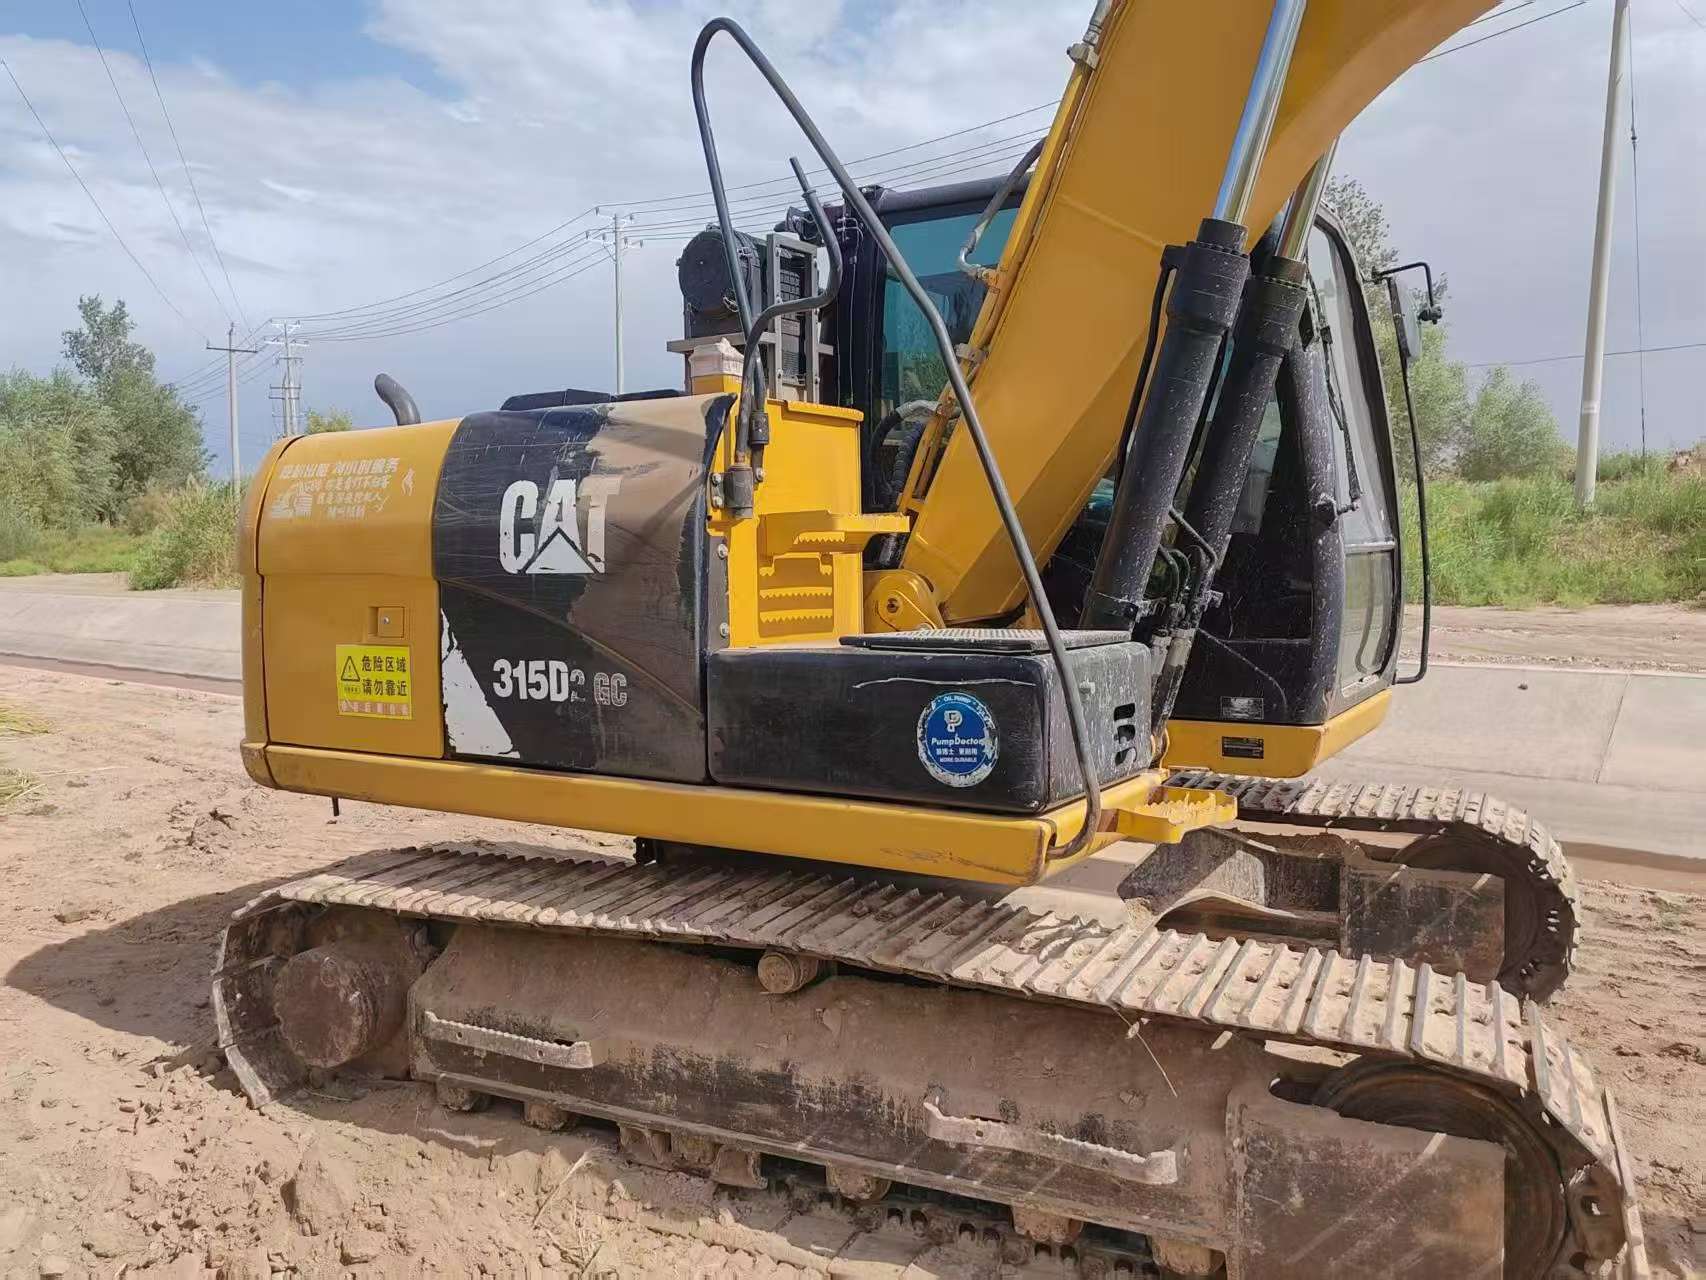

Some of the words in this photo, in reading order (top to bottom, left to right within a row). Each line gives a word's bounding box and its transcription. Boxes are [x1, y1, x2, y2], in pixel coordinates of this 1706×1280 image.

[500, 475, 623, 574] CAT
[361, 655, 407, 673] 危险区域
[362, 679, 407, 696] 请勿靠近
[593, 672, 628, 706] GC
